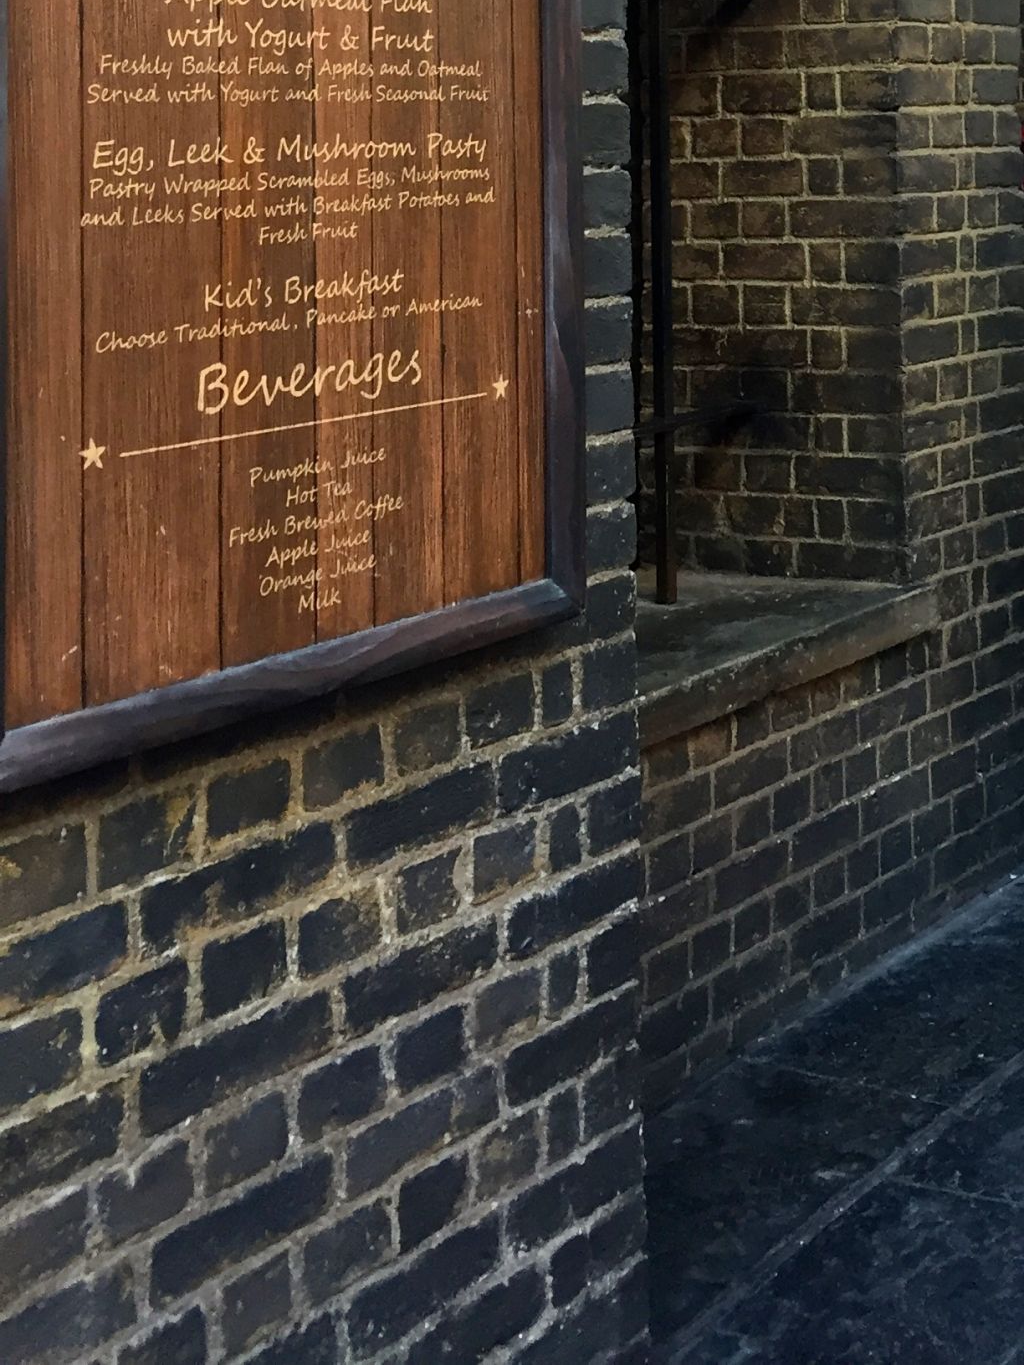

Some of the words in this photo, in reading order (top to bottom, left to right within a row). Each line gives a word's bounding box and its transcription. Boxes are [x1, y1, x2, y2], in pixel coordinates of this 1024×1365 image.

[167, 18, 238, 48] with
[245, 19, 330, 56] Yogurt
[341, 25, 359, 50] &
[372, 25, 434, 52] Fruit
[100, 55, 172, 77] Freshly
[183, 56, 240, 74] Baked
[248, 58, 288, 74] Flan
[295, 59, 312, 80] of
[319, 59, 374, 78] Apples
[380, 59, 411, 76] and
[418, 60, 482, 77] Oatmeal
[87, 84, 159, 104] Served
[168, 84, 215, 102] with
[221, 85, 278, 106] Yogurt
[285, 86, 320, 102] and
[328, 85, 371, 102] Fresh
[377, 85, 445, 102] Seasonal
[450, 85, 490, 102] Fruit
[93, 140, 154, 174] Egg,
[169, 138, 234, 167] Leek
[244, 138, 265, 162] &
[278, 133, 417, 163] Mushroom
[428, 133, 486, 161] Pasty
[90, 177, 155, 200] Pastry
[164, 171, 251, 197] Wrapped
[258, 170, 349, 192] Scrambled
[357, 169, 396, 189] Eggs,
[401, 166, 490, 184] Mushrooms
[81, 208, 124, 227] and
[133, 206, 185, 226] Leeks
[192, 202, 256, 224] Served
[265, 197, 308, 218] with
[314, 195, 391, 216] Breakfast
[399, 190, 460, 208] Potatoes
[466, 187, 496, 205] and
[259, 226, 308, 246] Fresh
[313, 220, 358, 241] Fruit
[204, 279, 272, 312] Kid's
[285, 268, 405, 307] Breakfast
[95, 330, 168, 354] Choose
[306, 304, 377, 328] Pancake
[382, 303, 399, 319] or
[406, 295, 483, 317] American
[197, 345, 422, 414] Beverages
[250, 459, 334, 488] Pumpkin
[341, 445, 386, 470] Juice
[286, 486, 318, 507] Hot
[324, 479, 352, 498] Tea
[229, 522, 277, 548] Fresh
[284, 505, 348, 534] Brewed
[354, 495, 404, 522] Coffee
[265, 538, 318, 567] Apple
[325, 529, 371, 550] Juice
[260, 567, 322, 597] Orange
[331, 554, 376, 577] Juice
[298, 588, 341, 614] Milk
